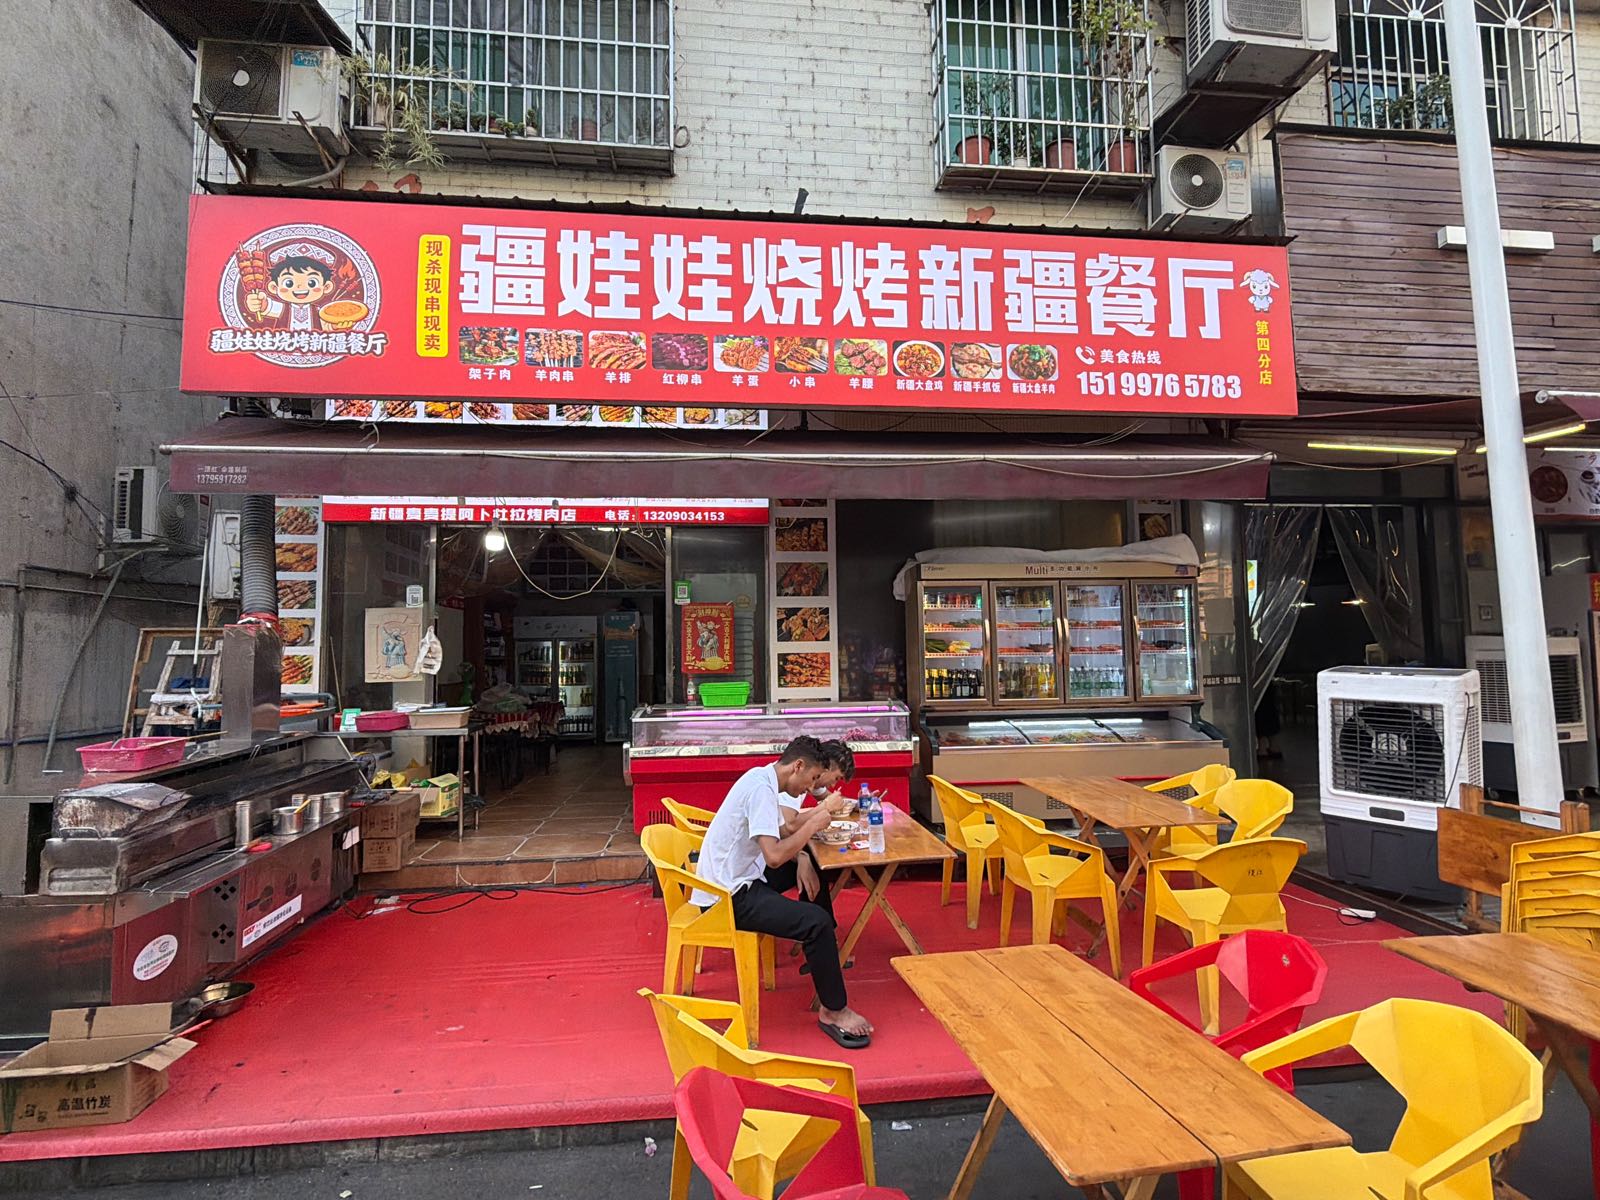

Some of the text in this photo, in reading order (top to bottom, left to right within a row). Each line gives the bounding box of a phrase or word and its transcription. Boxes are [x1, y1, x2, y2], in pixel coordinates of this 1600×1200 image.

[459, 223, 1235, 340] 疆娃娃烧烤新疆餐厅
[423, 240, 443, 351] 现杀现串现卖
[210, 328, 388, 357] 疆娃娃烧烤新疆餐厅
[1099, 348, 1162, 365] 美食热线
[1255, 320, 1273, 385] 第四分店
[468, 367, 511, 381] 架子肉
[535, 369, 575, 383] 羊肉串
[604, 371, 632, 384] 羊排
[662, 373, 702, 386] 红柳串
[731, 375, 759, 387] 羊蛋
[789, 376, 816, 388] 小串
[849, 377, 874, 390] 羊腰
[896, 379, 943, 392] 新疆大盘鸡
[953, 380, 1001, 393] 新疆手抓饭
[1076, 371, 1242, 399] 151 9976 5783
[1012, 382, 1056, 394] 新疆大盘羊肉
[643, 511, 725, 521] 13209034153
[1025, 566, 1048, 575] Multi
